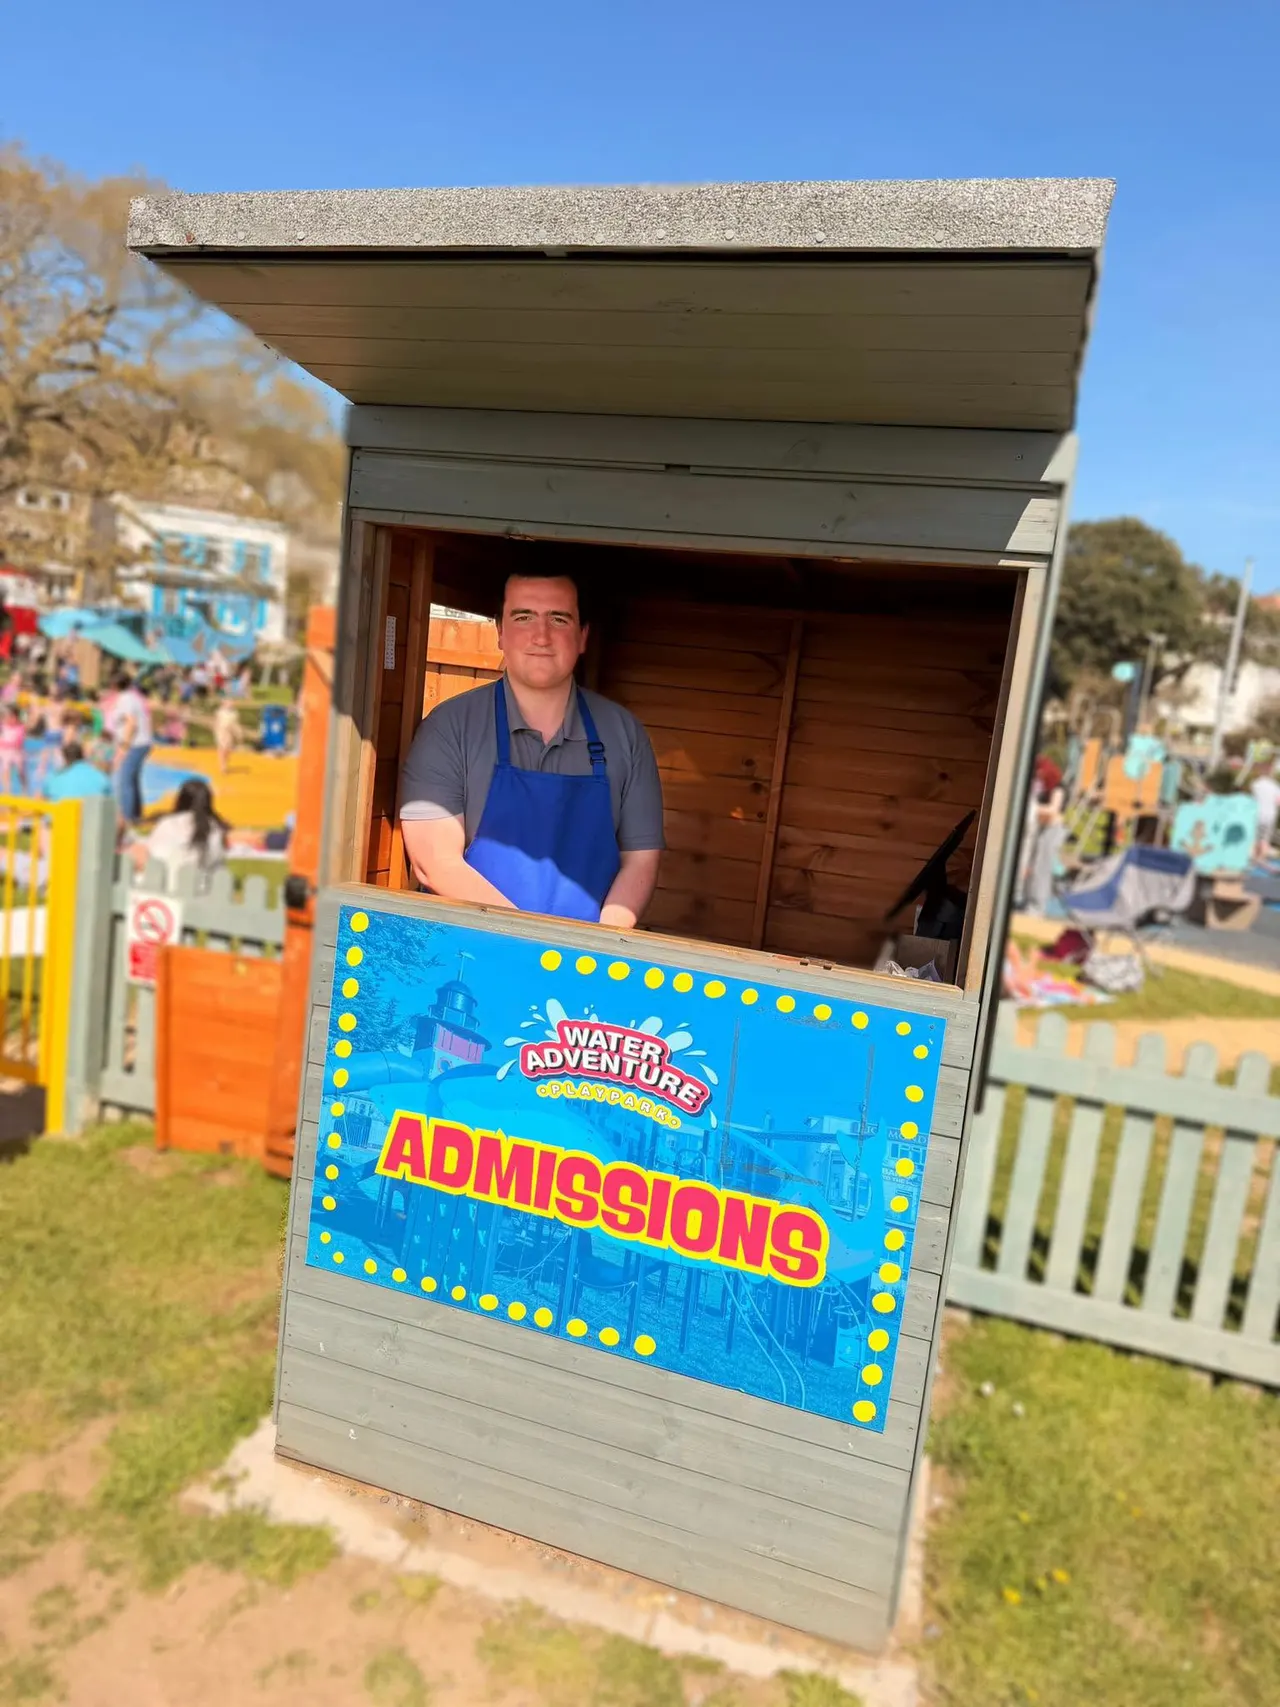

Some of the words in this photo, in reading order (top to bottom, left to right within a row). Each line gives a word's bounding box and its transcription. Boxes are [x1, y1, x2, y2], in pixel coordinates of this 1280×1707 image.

[563, 1026, 663, 1065] WATER
[526, 1047, 704, 1107] ADVENTURE
[551, 1080, 668, 1121] PLAYPARK
[381, 1115, 824, 1282] ADMISSIONS
